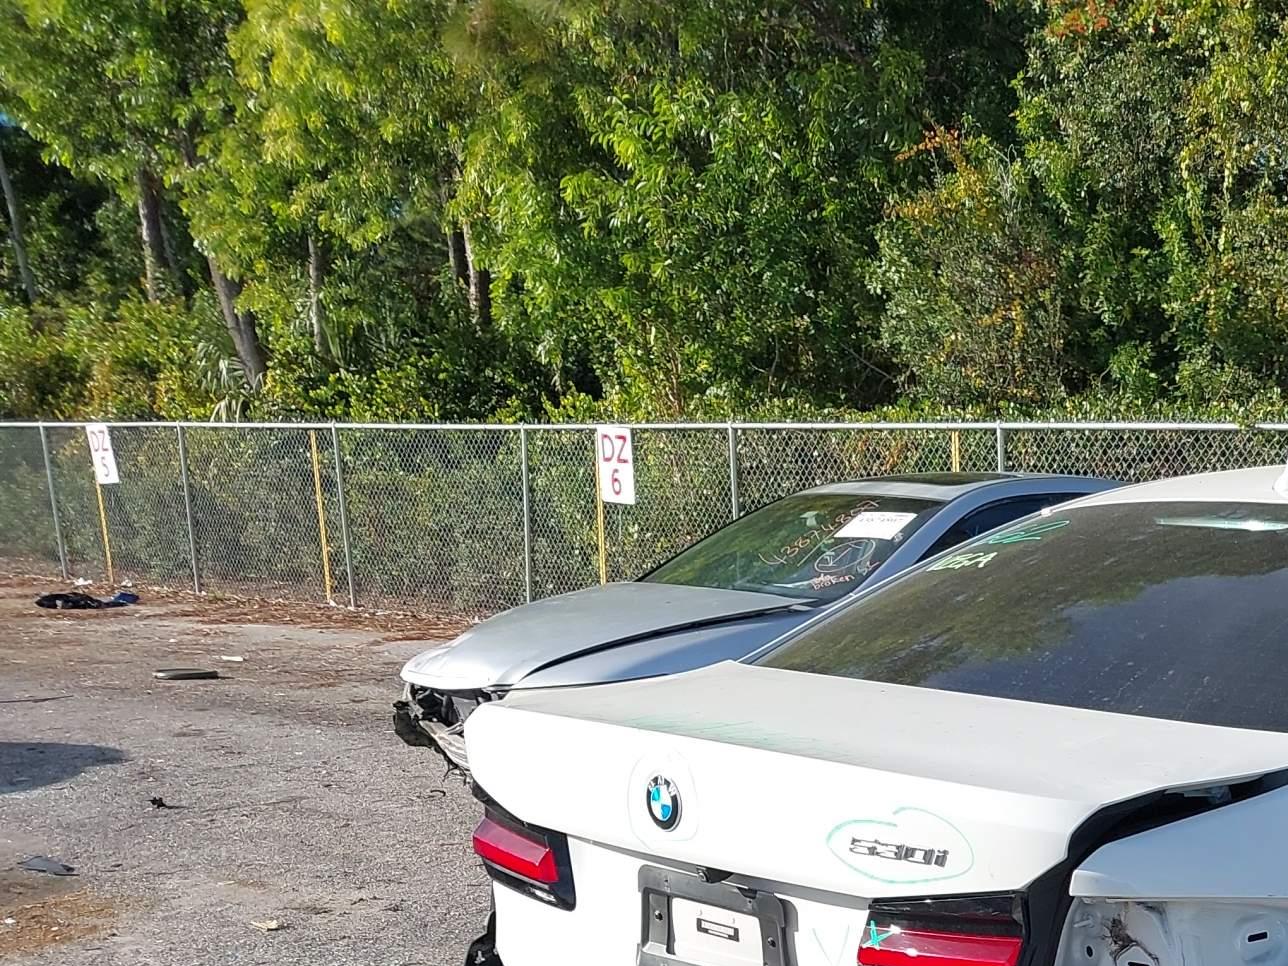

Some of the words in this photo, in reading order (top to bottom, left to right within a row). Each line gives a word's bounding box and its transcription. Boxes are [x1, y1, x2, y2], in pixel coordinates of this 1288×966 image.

[89, 430, 109, 452] DZ
[601, 434, 629, 463] DZ
[101, 456, 110, 477] 5
[611, 468, 622, 496] 6
[849, 837, 949, 868] 530i
